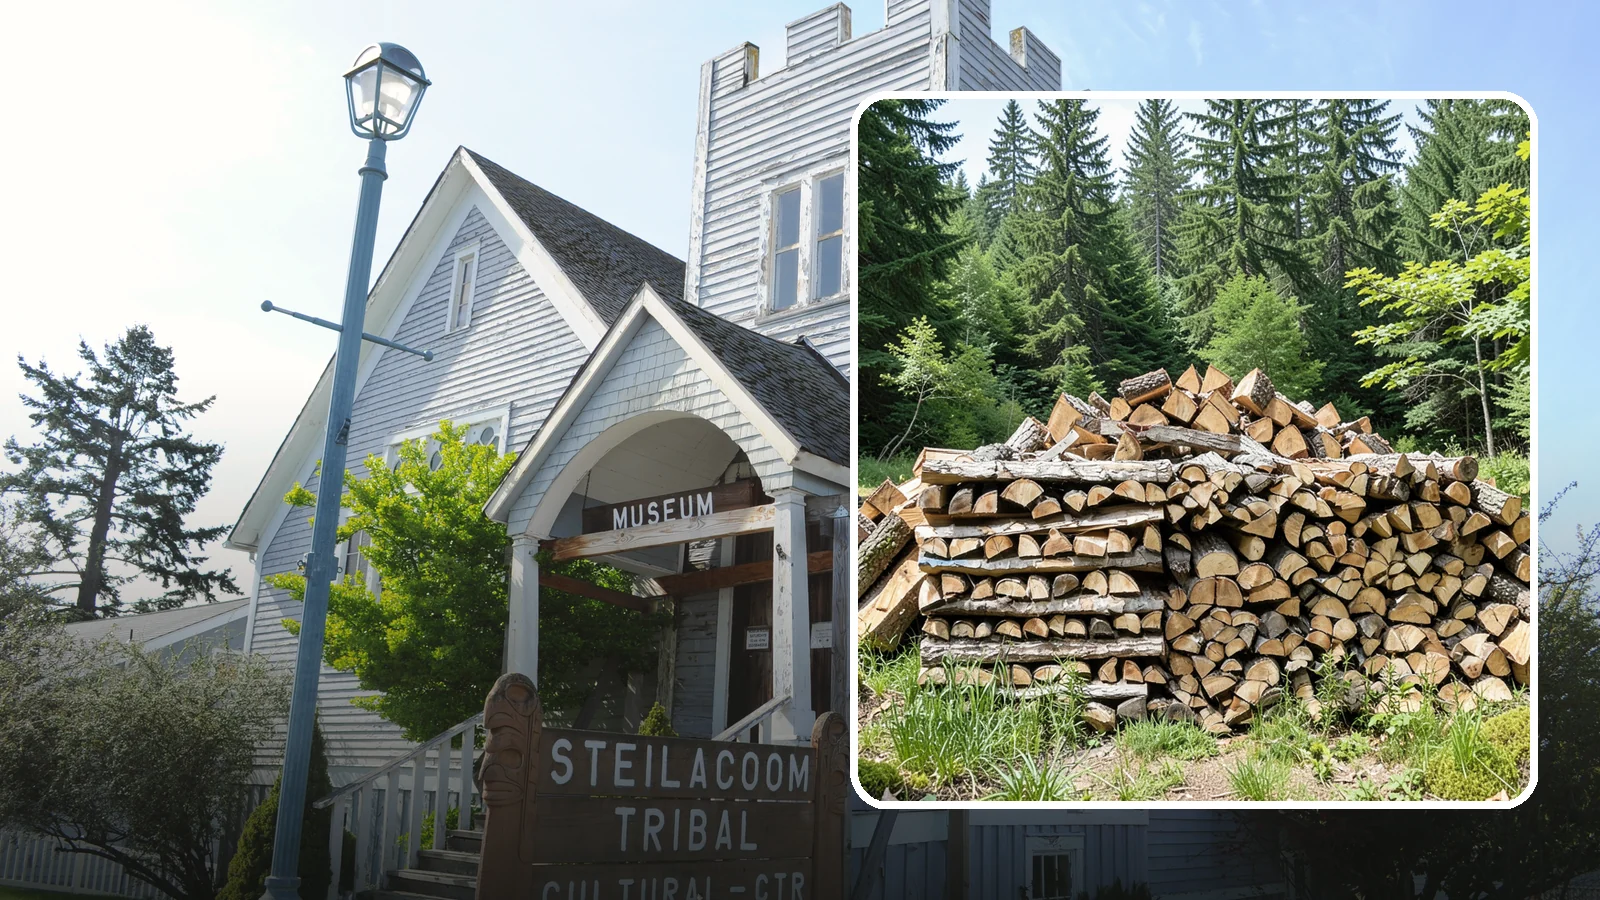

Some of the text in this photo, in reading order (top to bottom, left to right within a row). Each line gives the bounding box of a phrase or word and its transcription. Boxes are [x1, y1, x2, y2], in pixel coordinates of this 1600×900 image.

[613, 491, 713, 530] MUSEUM
[551, 738, 809, 792] STEILACOOM
[615, 806, 758, 851] TRIBAL
